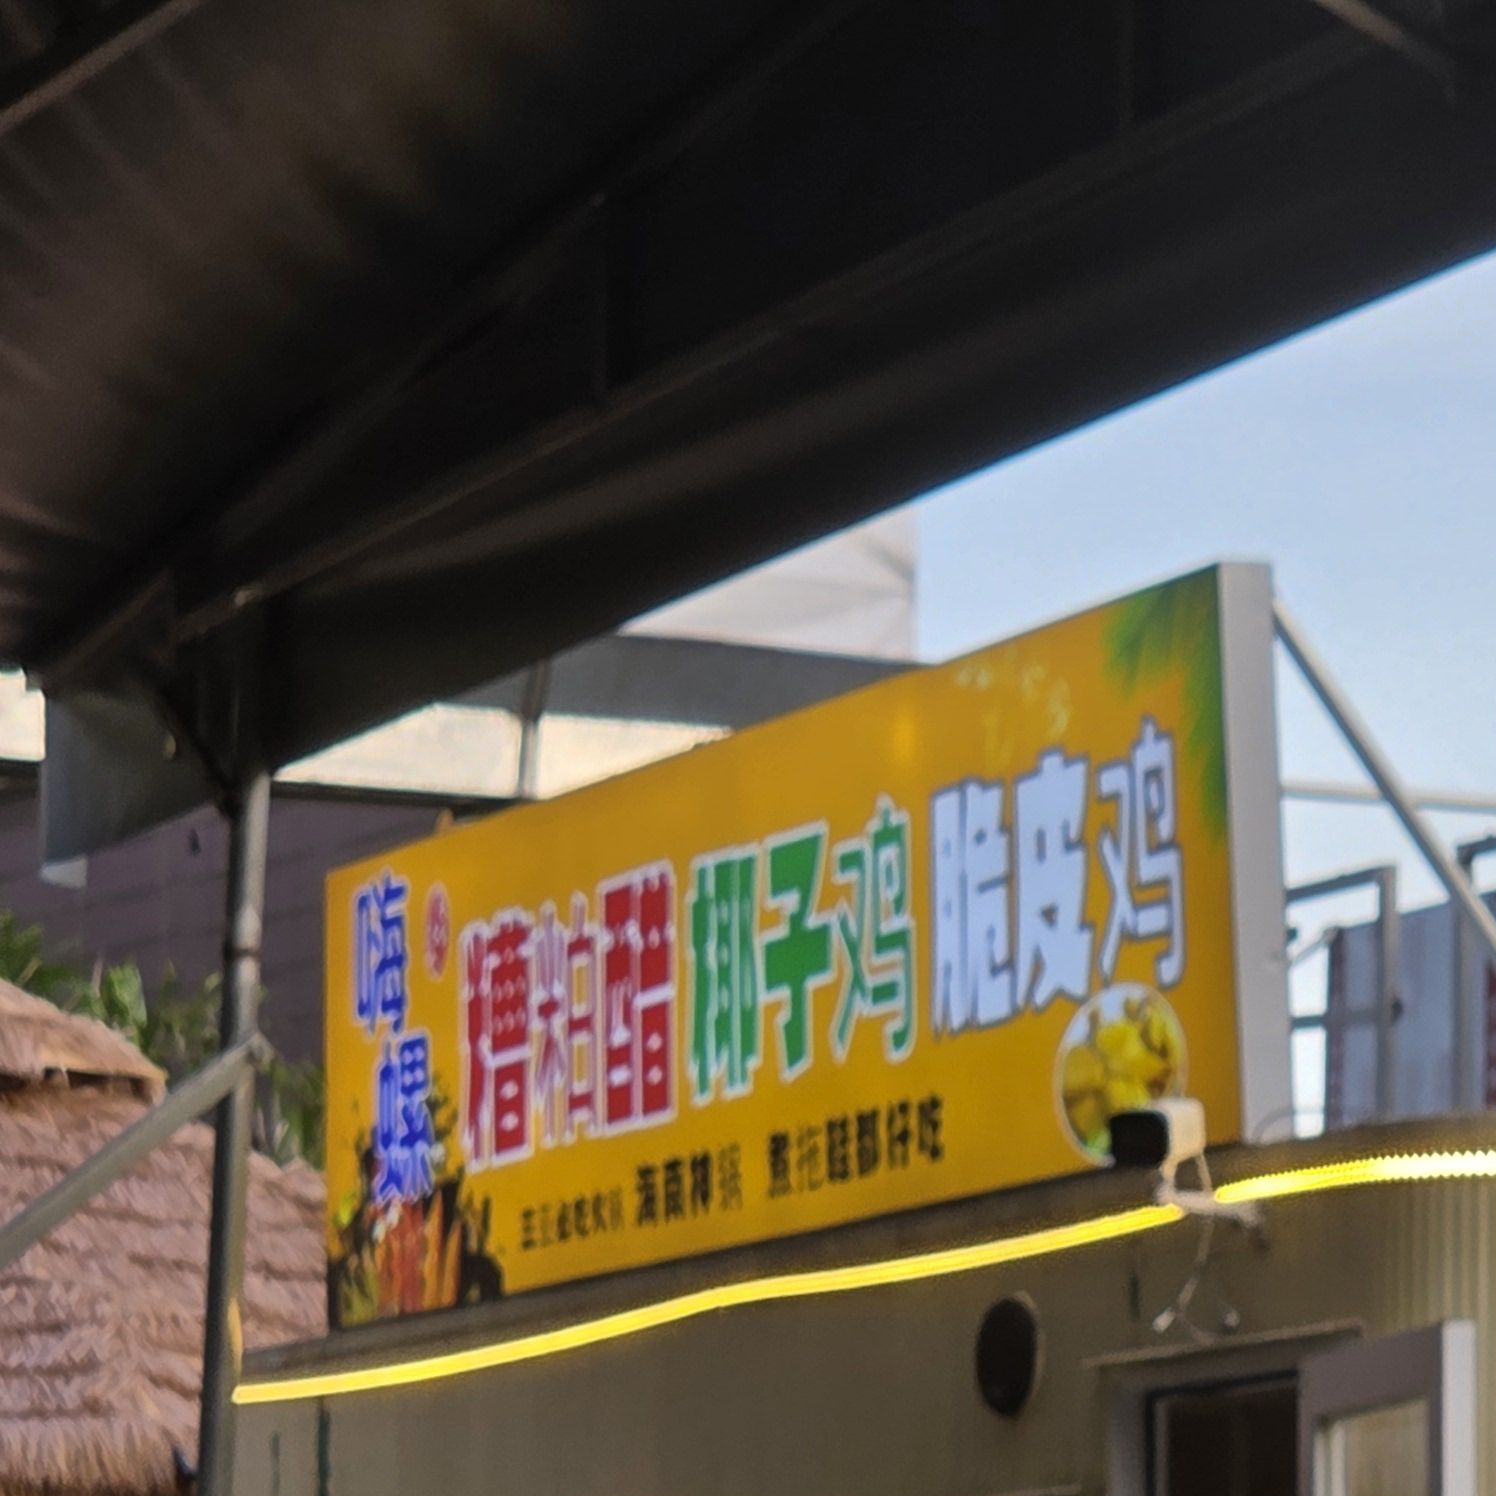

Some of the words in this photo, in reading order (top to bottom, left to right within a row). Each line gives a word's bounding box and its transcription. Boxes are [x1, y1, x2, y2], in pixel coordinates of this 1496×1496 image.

[353, 867, 434, 1203] 嗨螺
[459, 859, 677, 1175] 糟粕醋
[687, 790, 917, 1106] 椰子鸡
[930, 714, 1187, 1036] 脆皮鸡
